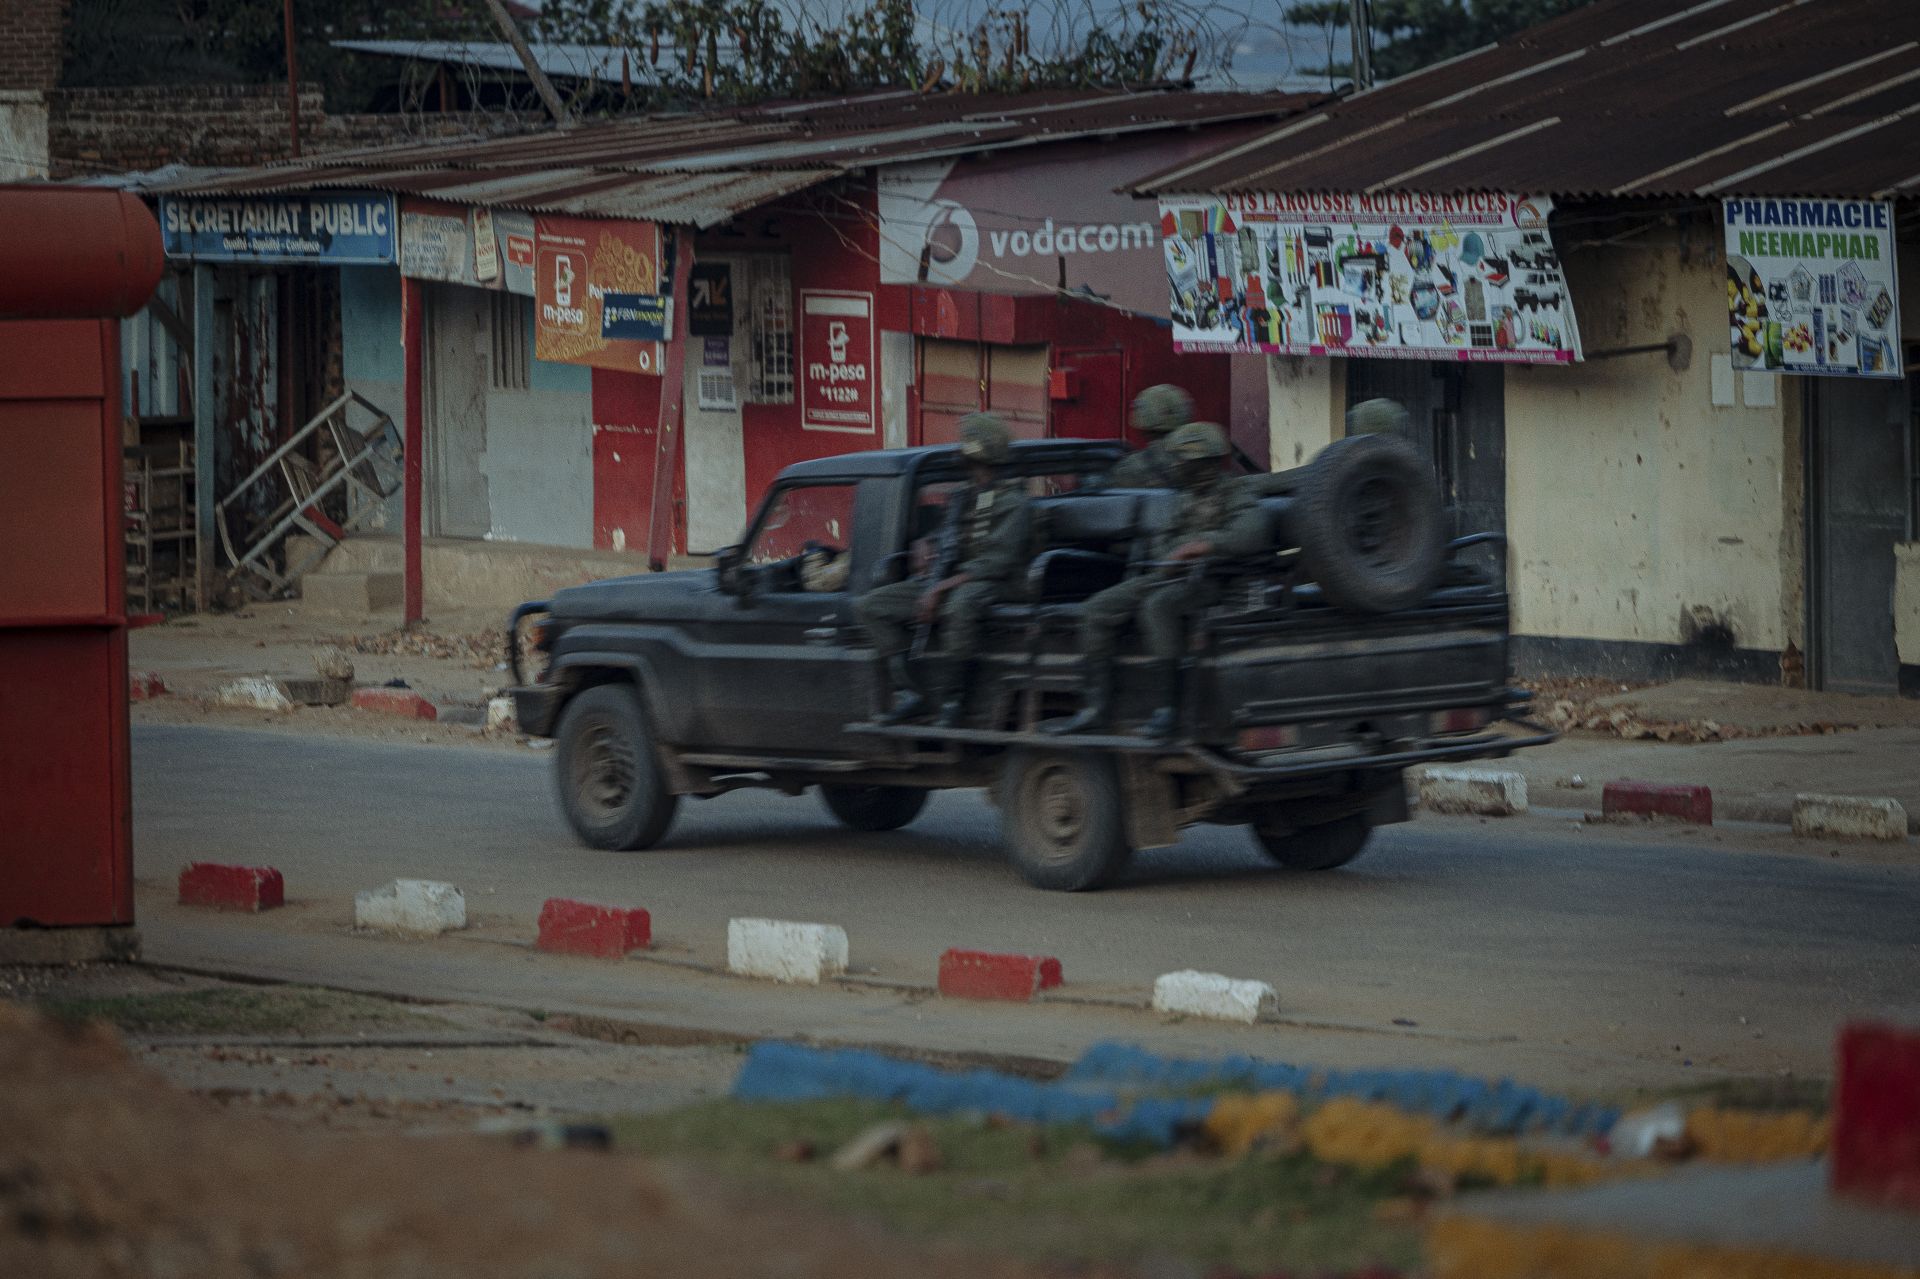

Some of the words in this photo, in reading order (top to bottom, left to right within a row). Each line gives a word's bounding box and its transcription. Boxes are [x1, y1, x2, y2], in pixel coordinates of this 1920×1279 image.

[1226, 193, 1258, 211] ETS
[1263, 192, 1354, 212] LAROUSSE
[1359, 192, 1508, 213] MULTI-SERVICES
[1726, 200, 1888, 229] PHARMACIE
[166, 202, 302, 234] SECRETARIAT
[310, 203, 387, 236] PUBLIC
[990, 217, 1155, 257] vodacom
[1738, 230, 1881, 260] NEEMAPHAR
